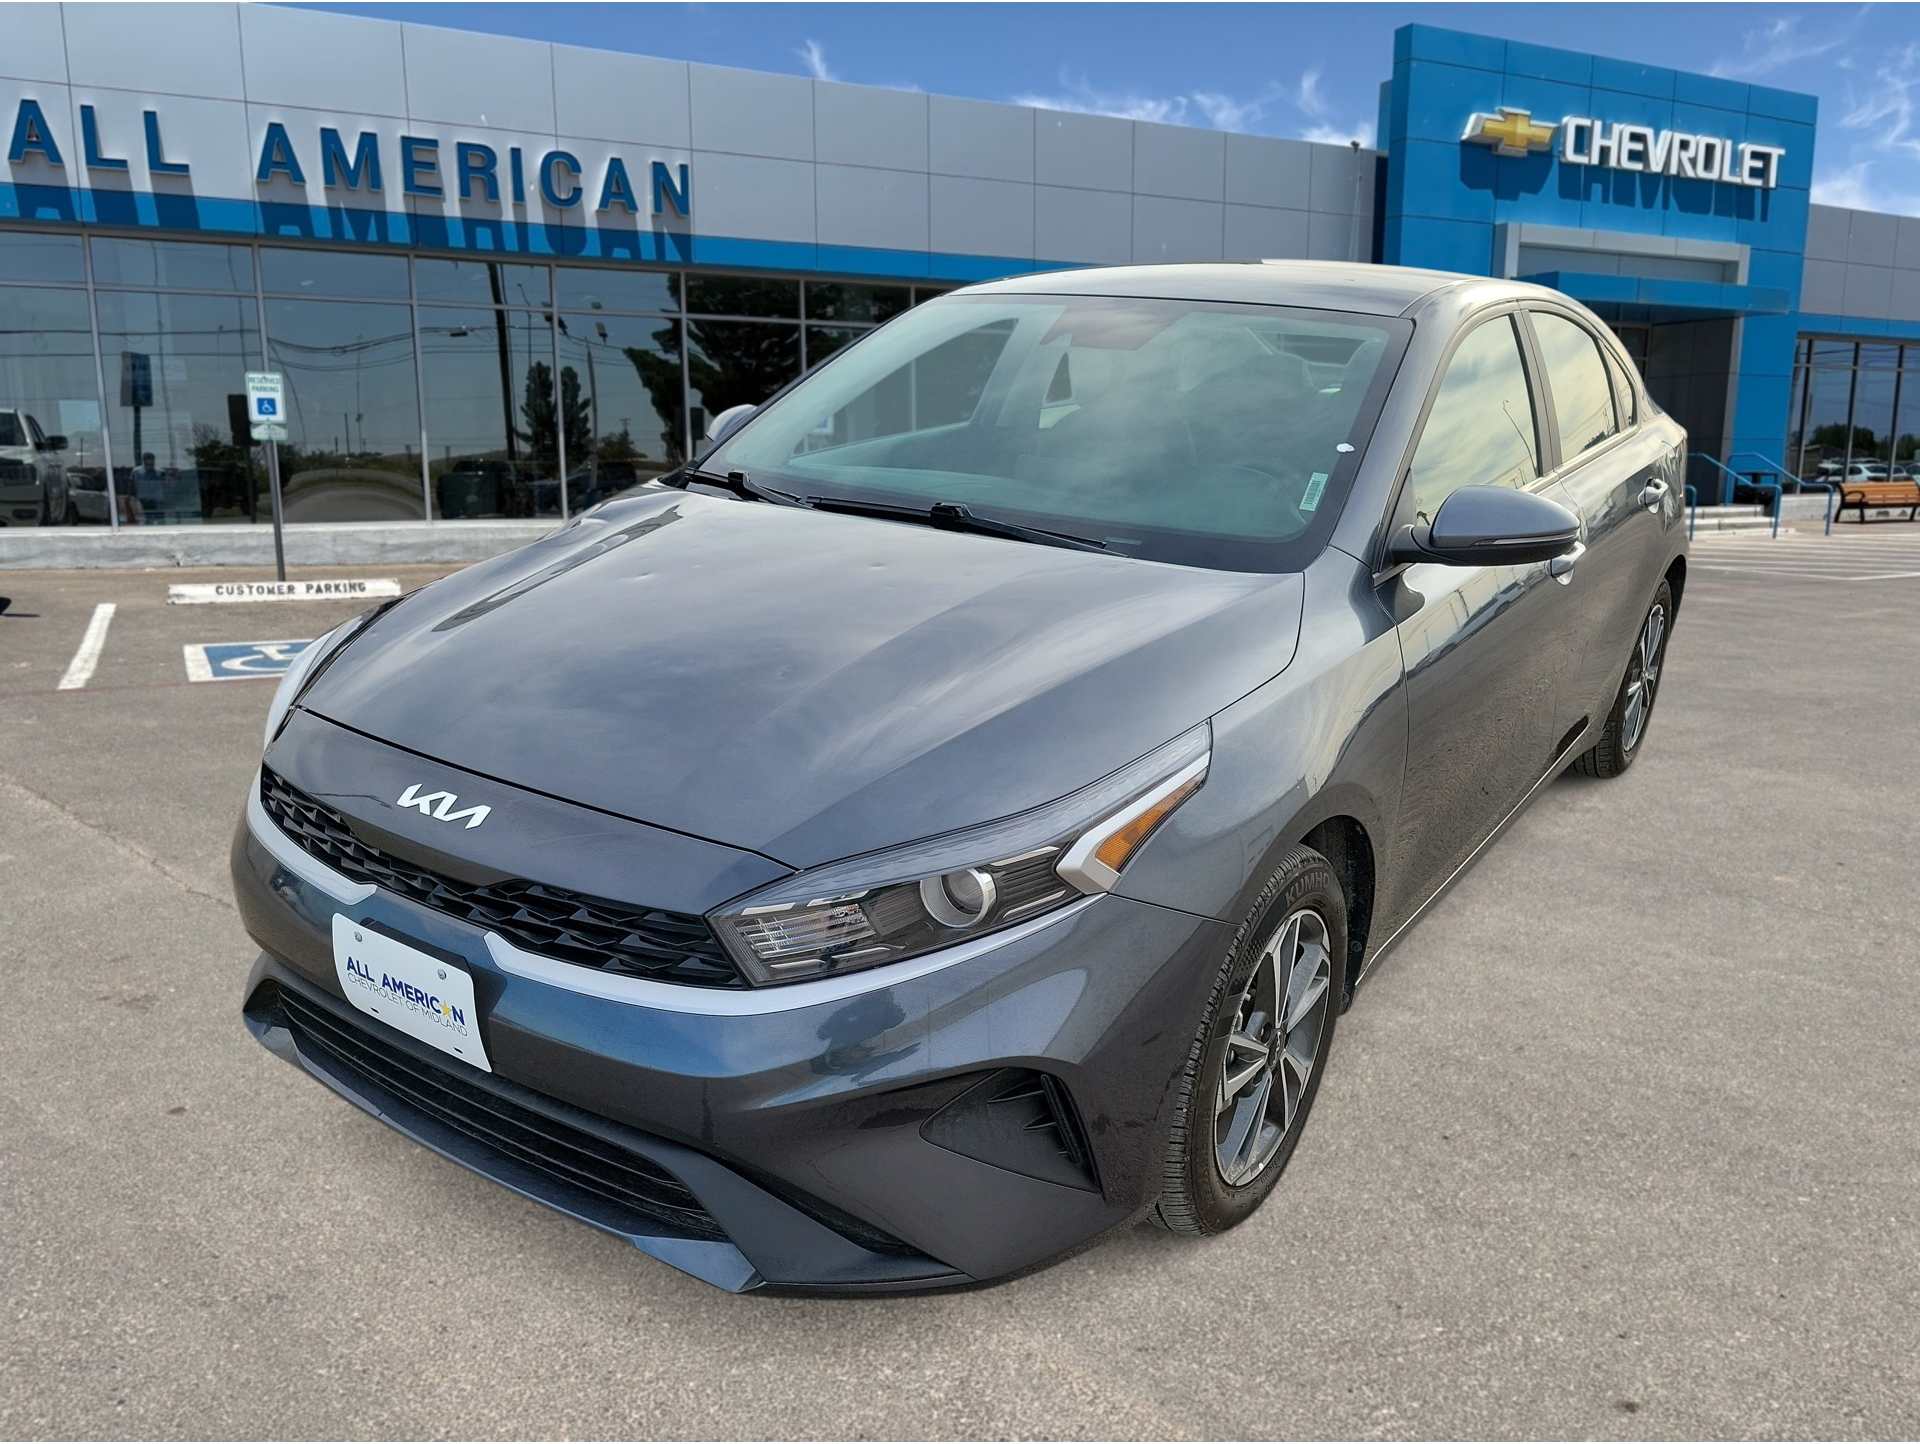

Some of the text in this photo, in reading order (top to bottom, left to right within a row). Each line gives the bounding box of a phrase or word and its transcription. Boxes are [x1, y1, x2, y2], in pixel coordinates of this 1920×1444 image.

[8, 98, 690, 217] ALL AMERICAN
[1561, 115, 1786, 189] CHEVROLET
[215, 582, 367, 596] CUSTOMER PARKING
[346, 956, 375, 983] ALL
[347, 973, 468, 1037] CHEVROLET OF MIDLAND
